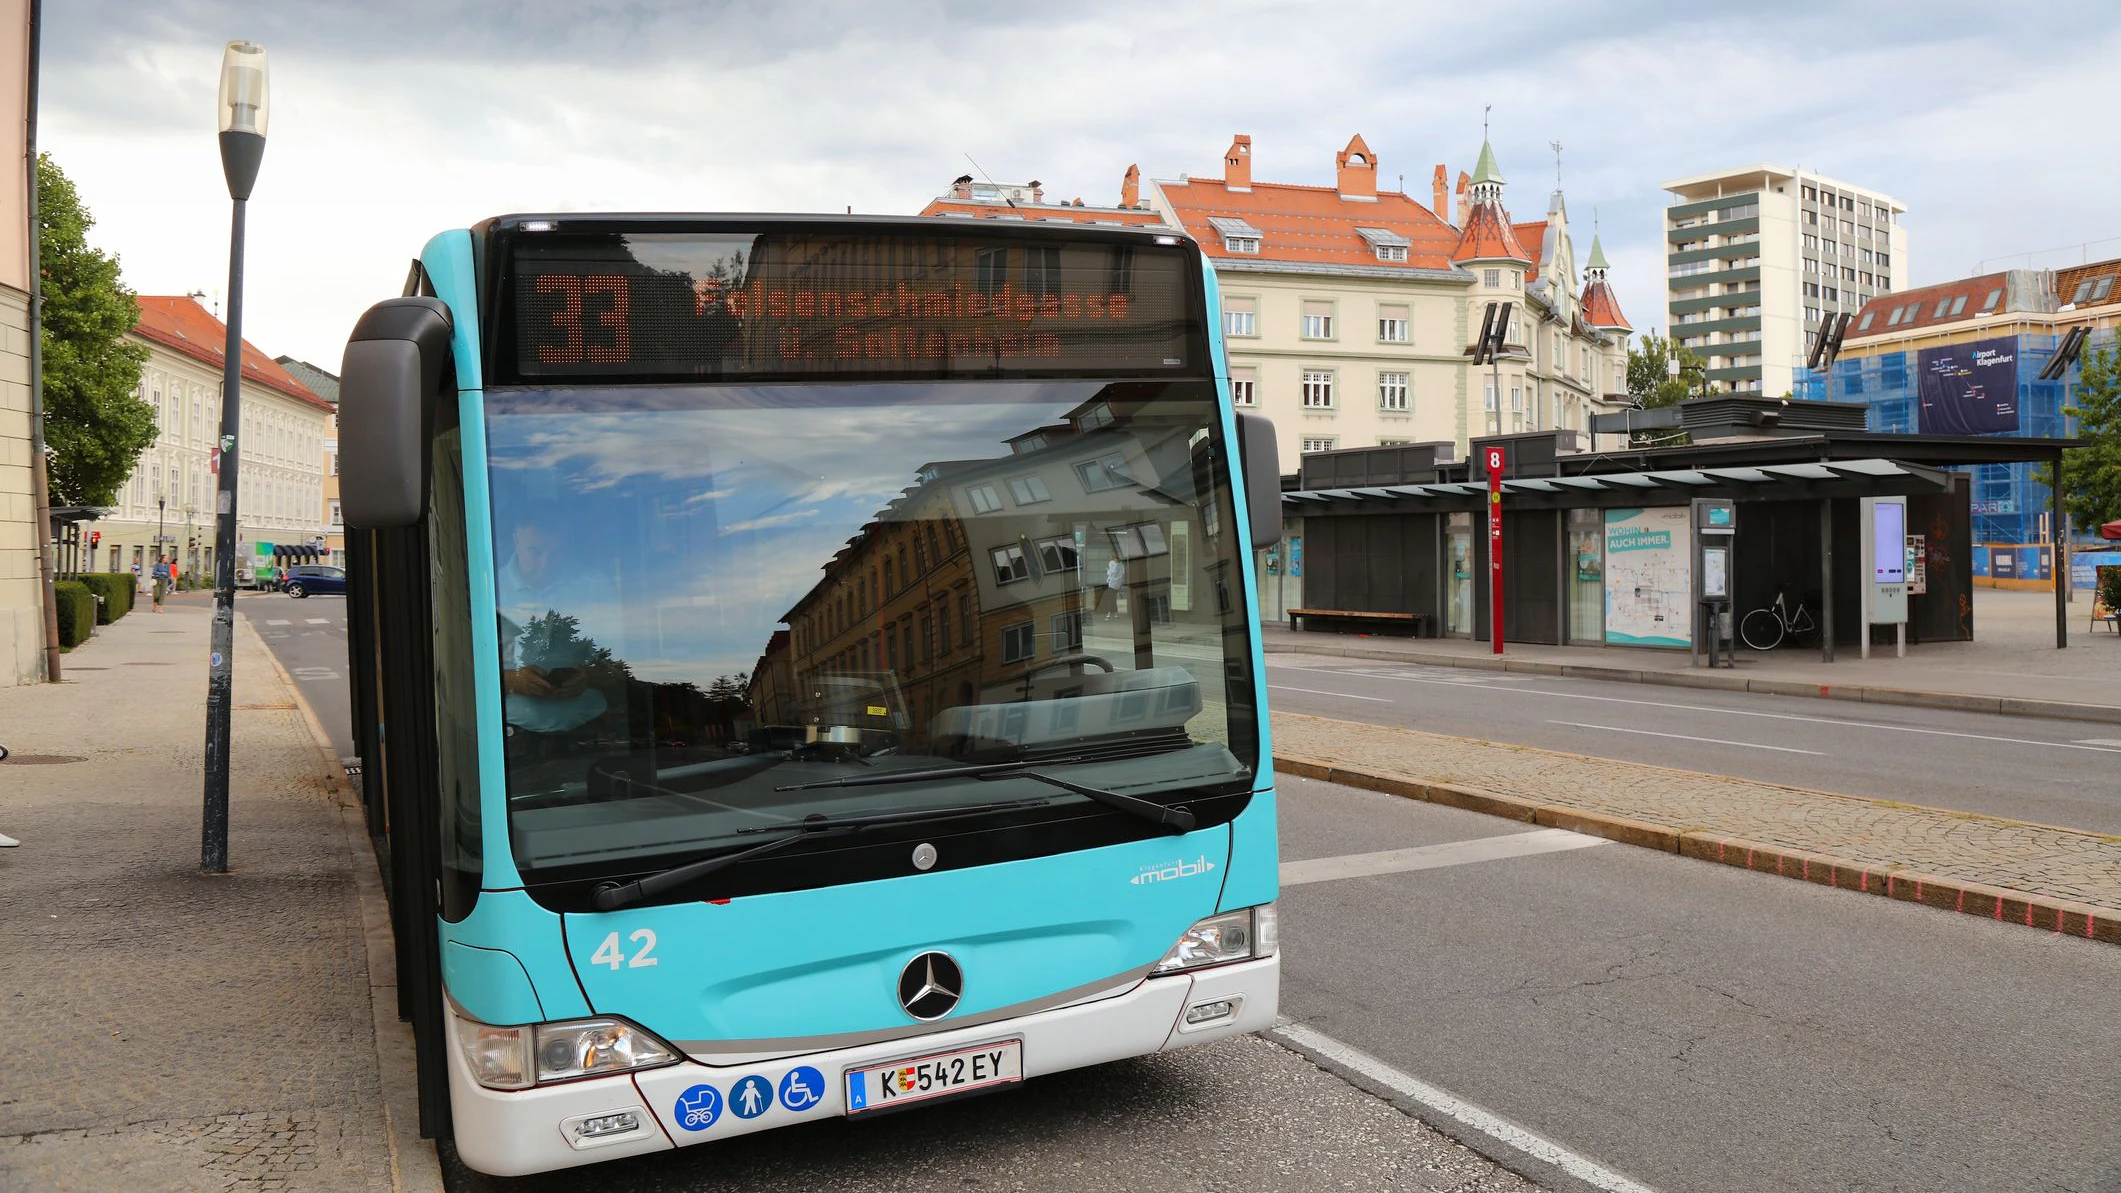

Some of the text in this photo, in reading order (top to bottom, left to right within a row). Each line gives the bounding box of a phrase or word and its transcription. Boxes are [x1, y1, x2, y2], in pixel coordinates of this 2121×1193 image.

[696, 278, 1129, 320] Felsenschmiedgasse
[537, 274, 630, 363] 33
[835, 326, 1061, 357] Seltenheim
[1972, 349, 1996, 359] Airport
[1976, 355, 2013, 366] Klagenfurt
[1490, 452, 1500, 468] 8
[1971, 502, 1999, 513] PAR
[1608, 526, 1641, 537] WOHIN
[1610, 535, 1670, 549] AUCH IMMER.
[1140, 854, 1206, 885] mobil
[590, 927, 658, 971] 42
[881, 1050, 1003, 1099] K 542 EY
[855, 1095, 863, 1104] A
